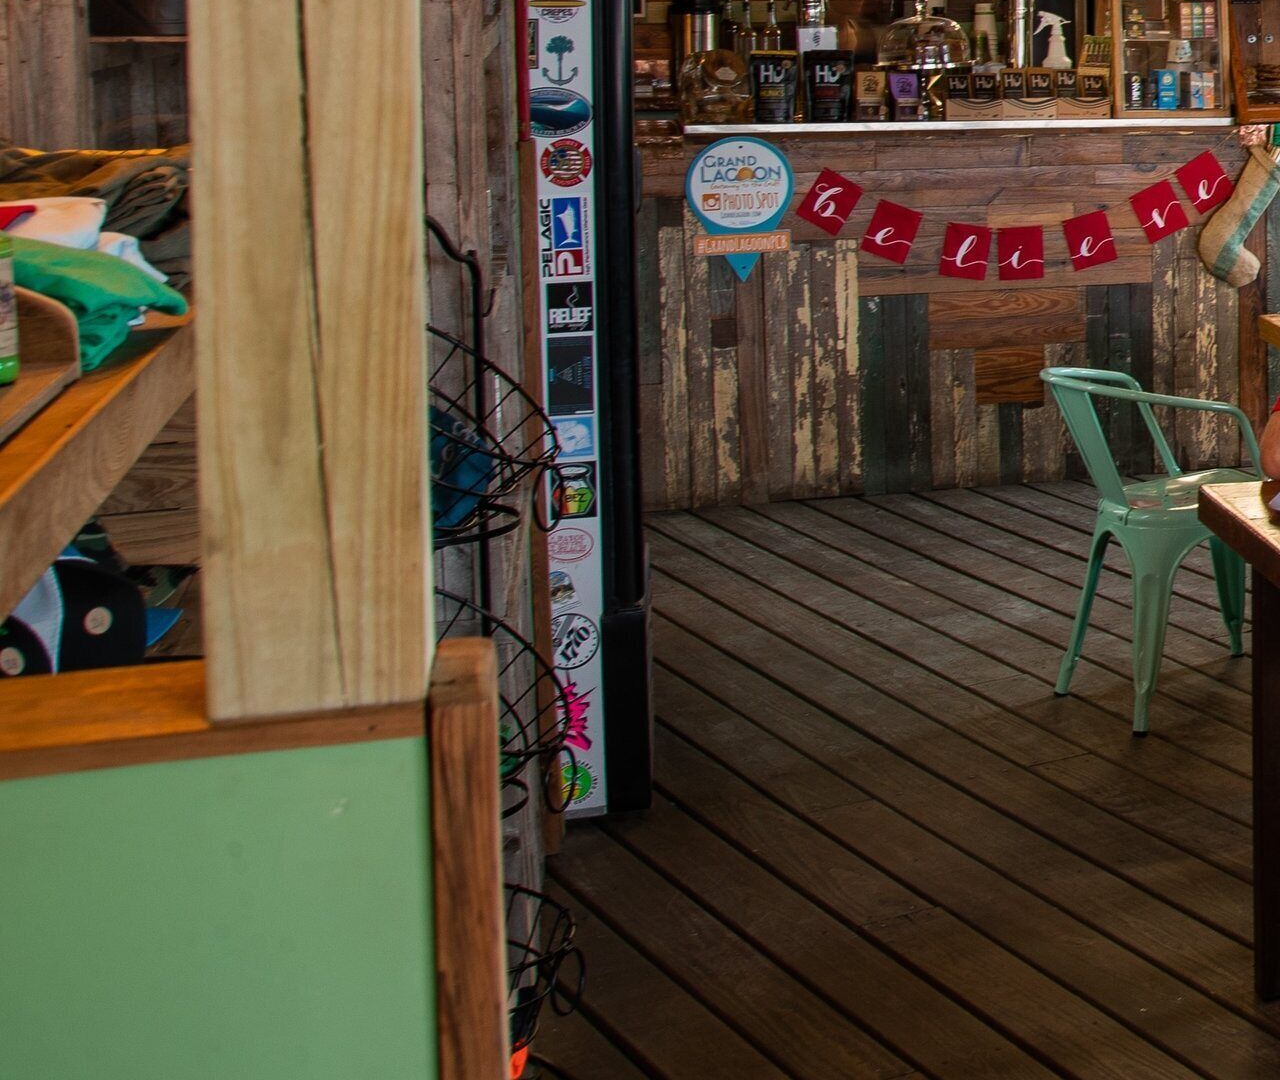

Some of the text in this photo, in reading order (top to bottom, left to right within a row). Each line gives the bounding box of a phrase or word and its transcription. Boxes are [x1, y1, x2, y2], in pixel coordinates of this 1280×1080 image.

[703, 155, 757, 168] GRAND
[723, 191, 779, 210] PHOTO SPOT
